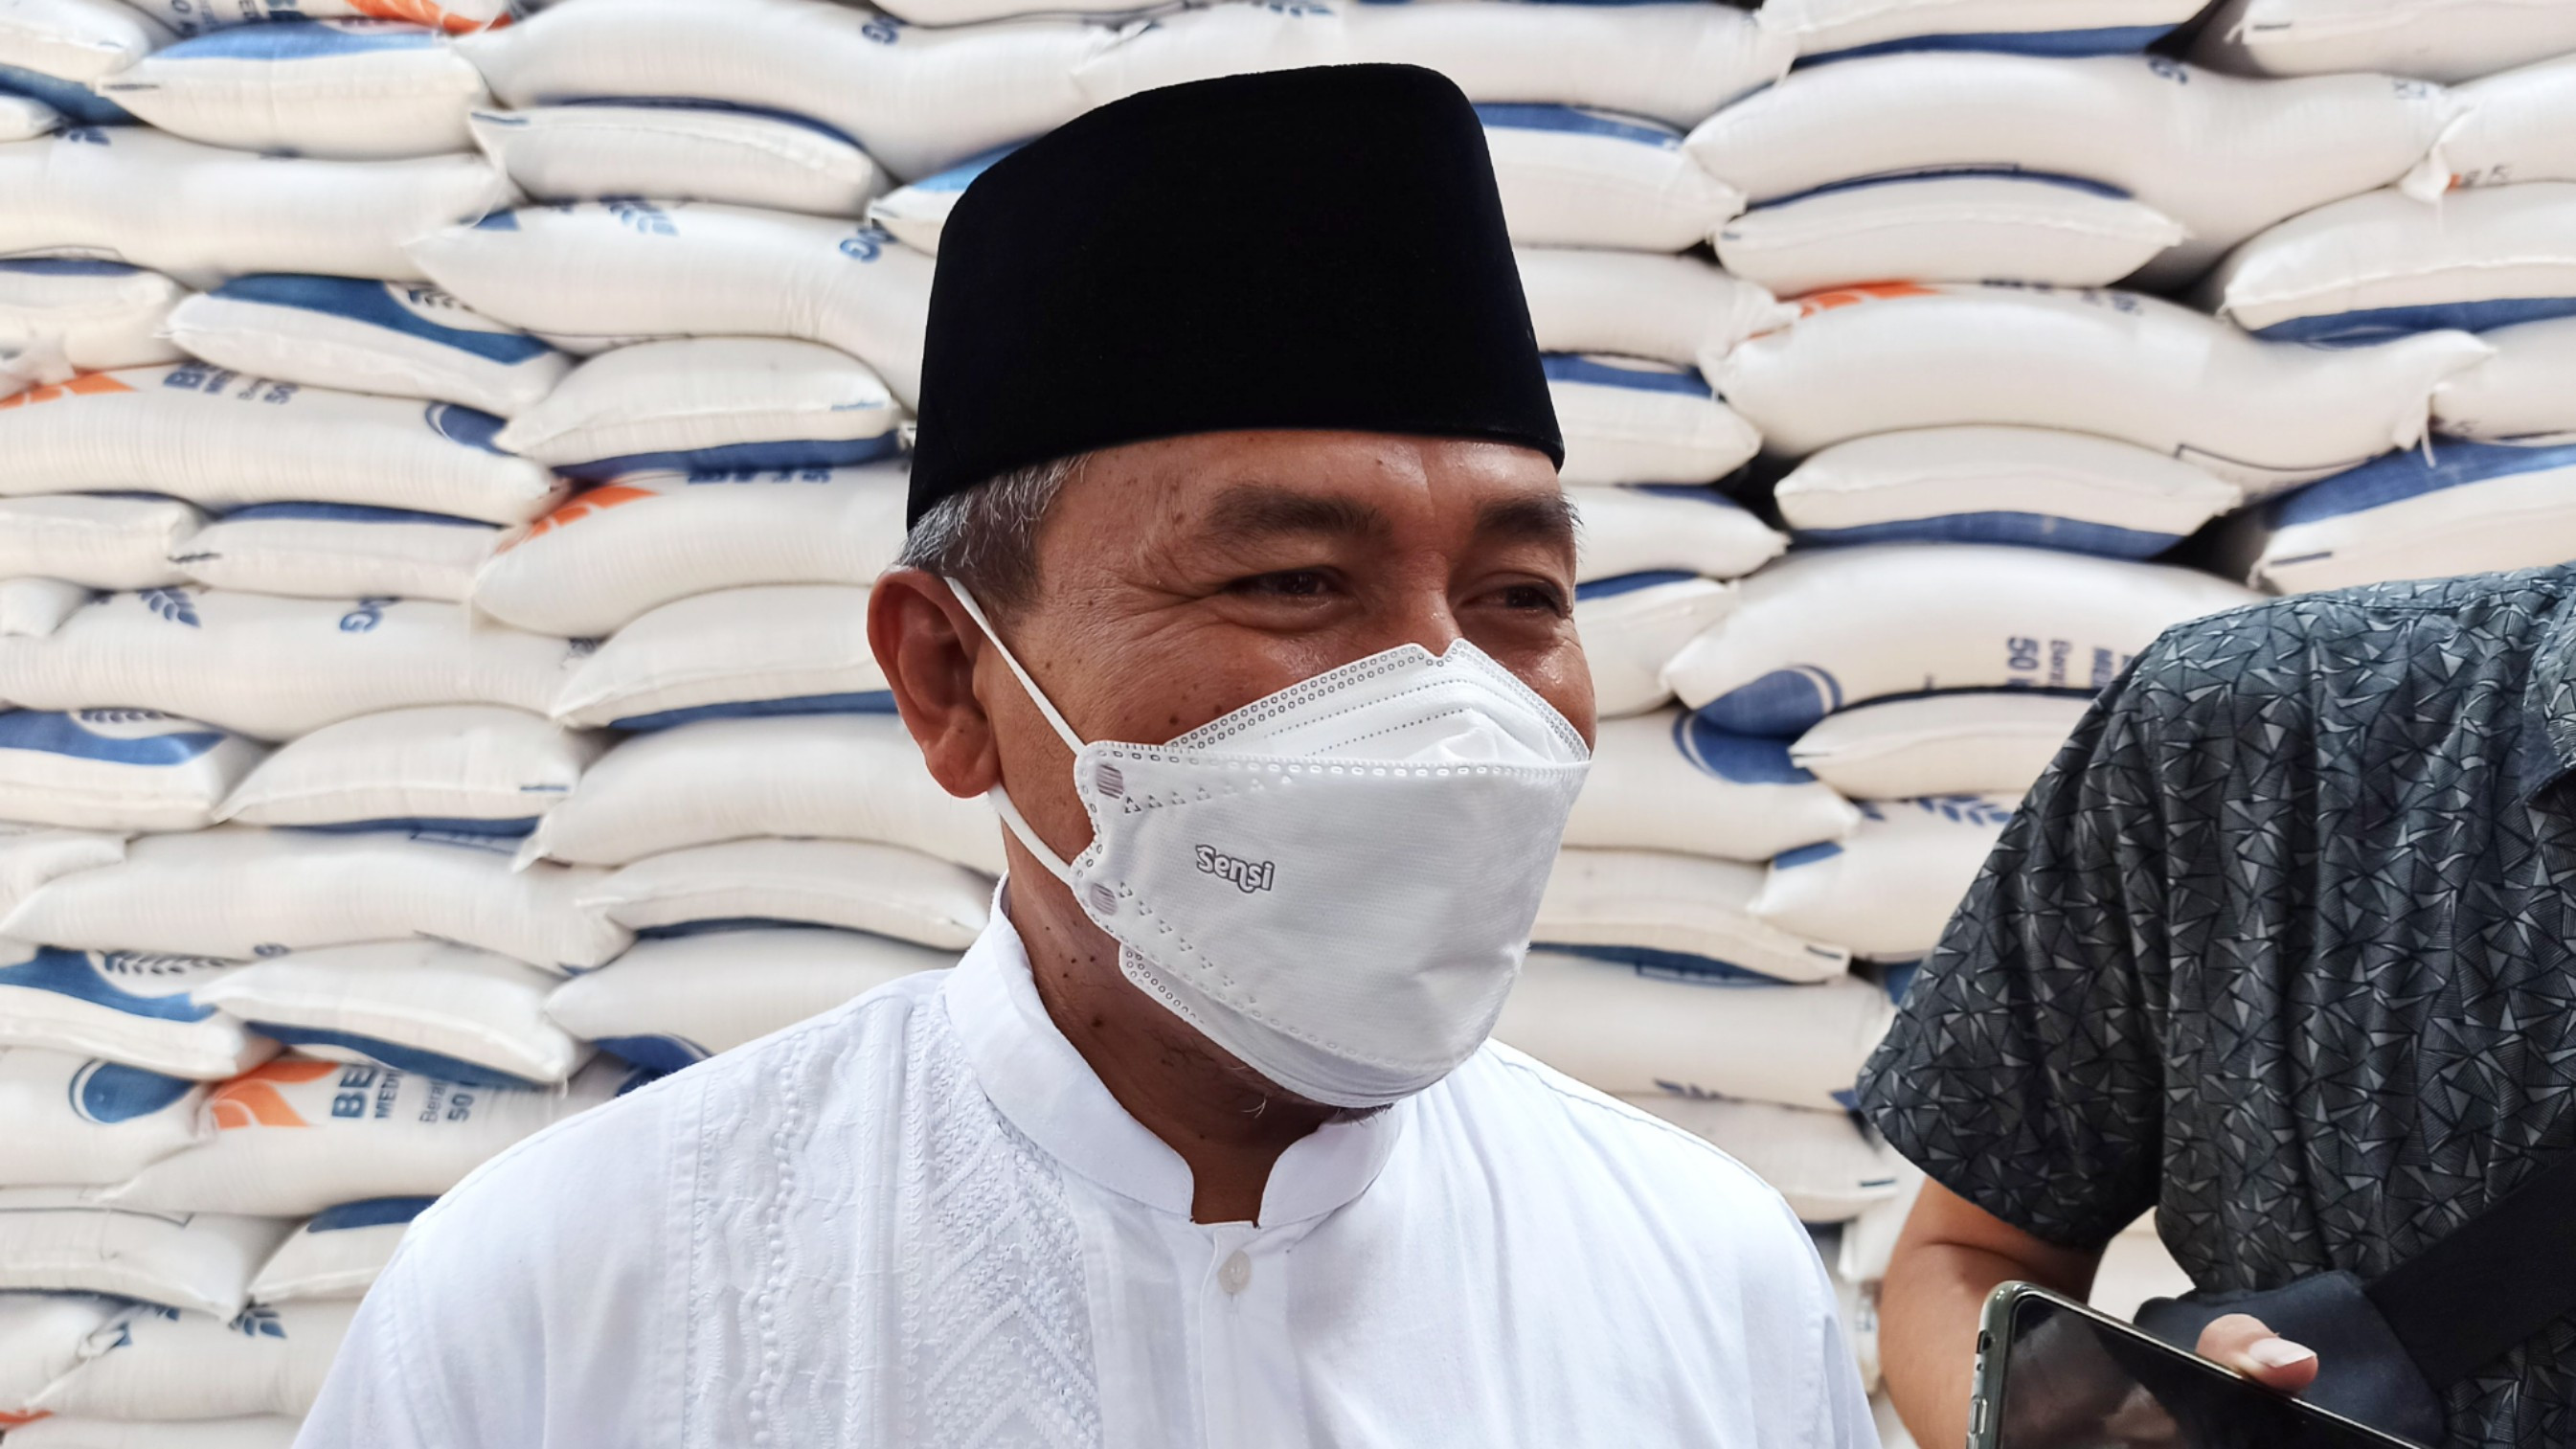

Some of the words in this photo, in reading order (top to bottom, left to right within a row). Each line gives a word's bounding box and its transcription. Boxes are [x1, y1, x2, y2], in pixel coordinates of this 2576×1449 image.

[2007, 636, 2039, 669] 50
[1195, 844, 1276, 894] Sensi
[447, 1093, 475, 1122] 50
